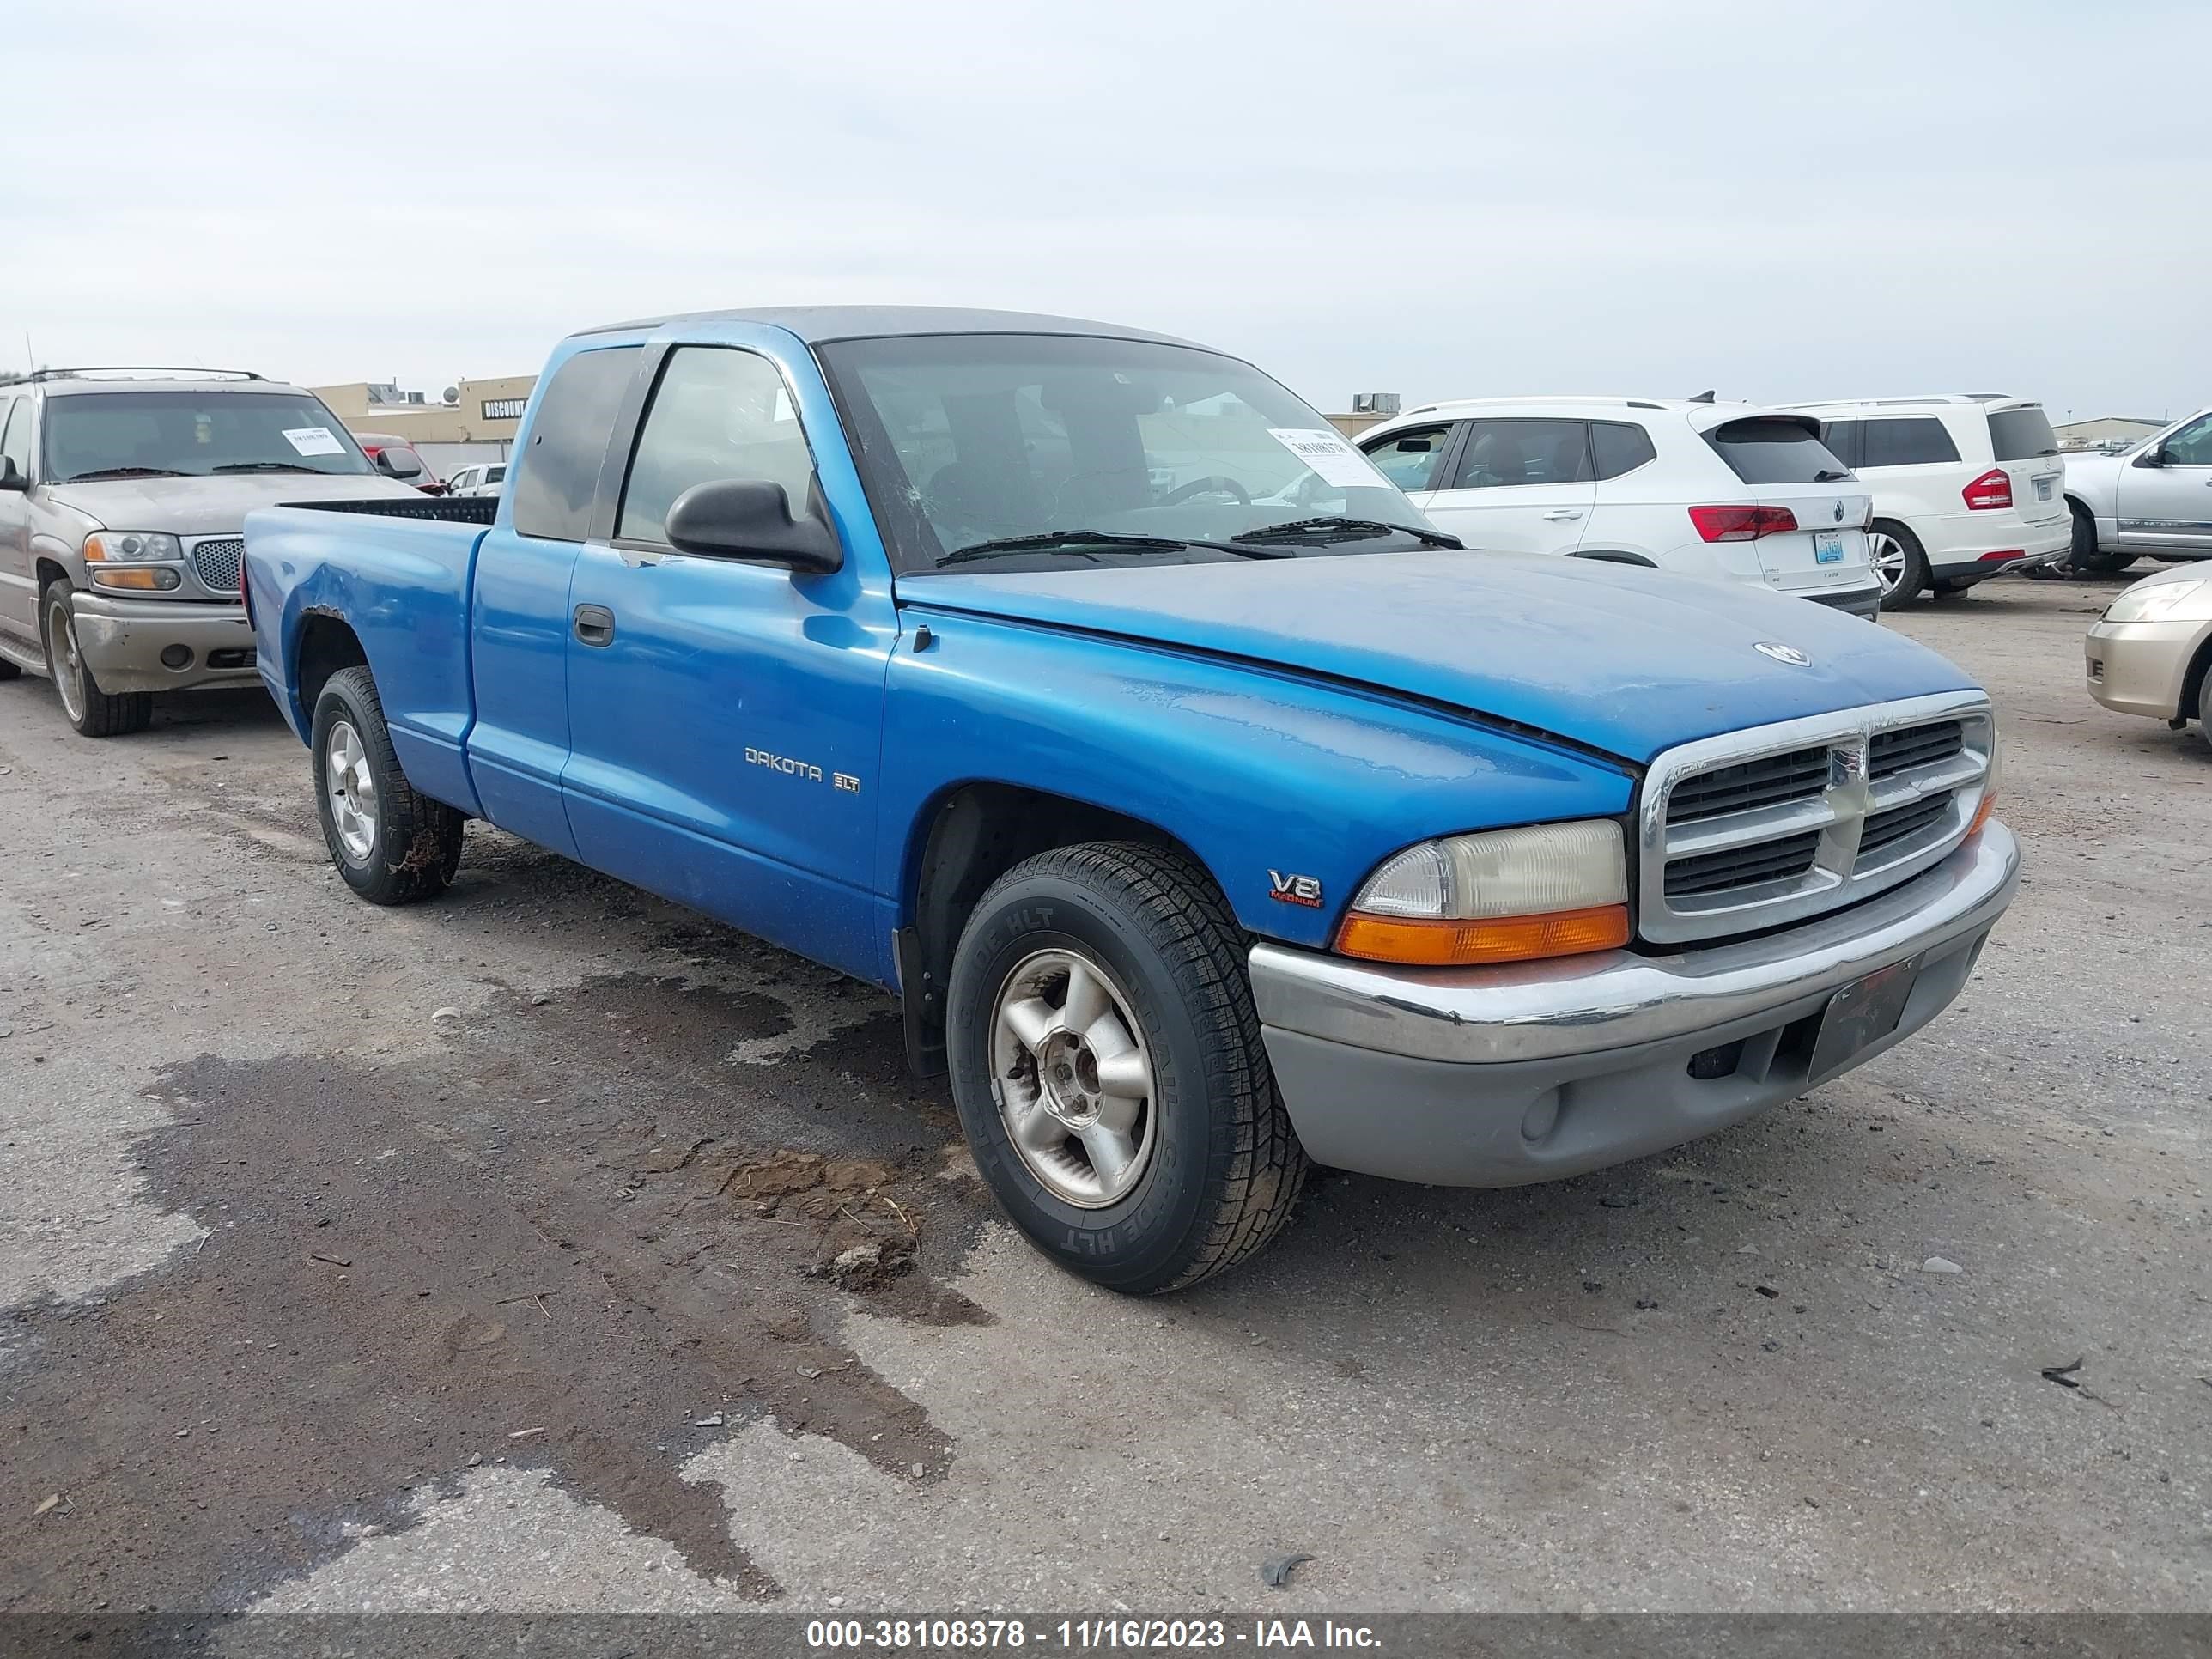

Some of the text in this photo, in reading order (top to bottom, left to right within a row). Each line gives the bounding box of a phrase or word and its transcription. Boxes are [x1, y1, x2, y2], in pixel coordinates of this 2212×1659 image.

[485, 400, 525, 417] DISCOUNT
[744, 747, 858, 791] DAKOTA SLT
[1267, 869, 1321, 899] V8
[1270, 890, 1320, 908] MAGNUM
[1006, 907, 1054, 935] HLT
[1060, 1229, 1116, 1255] HLT
